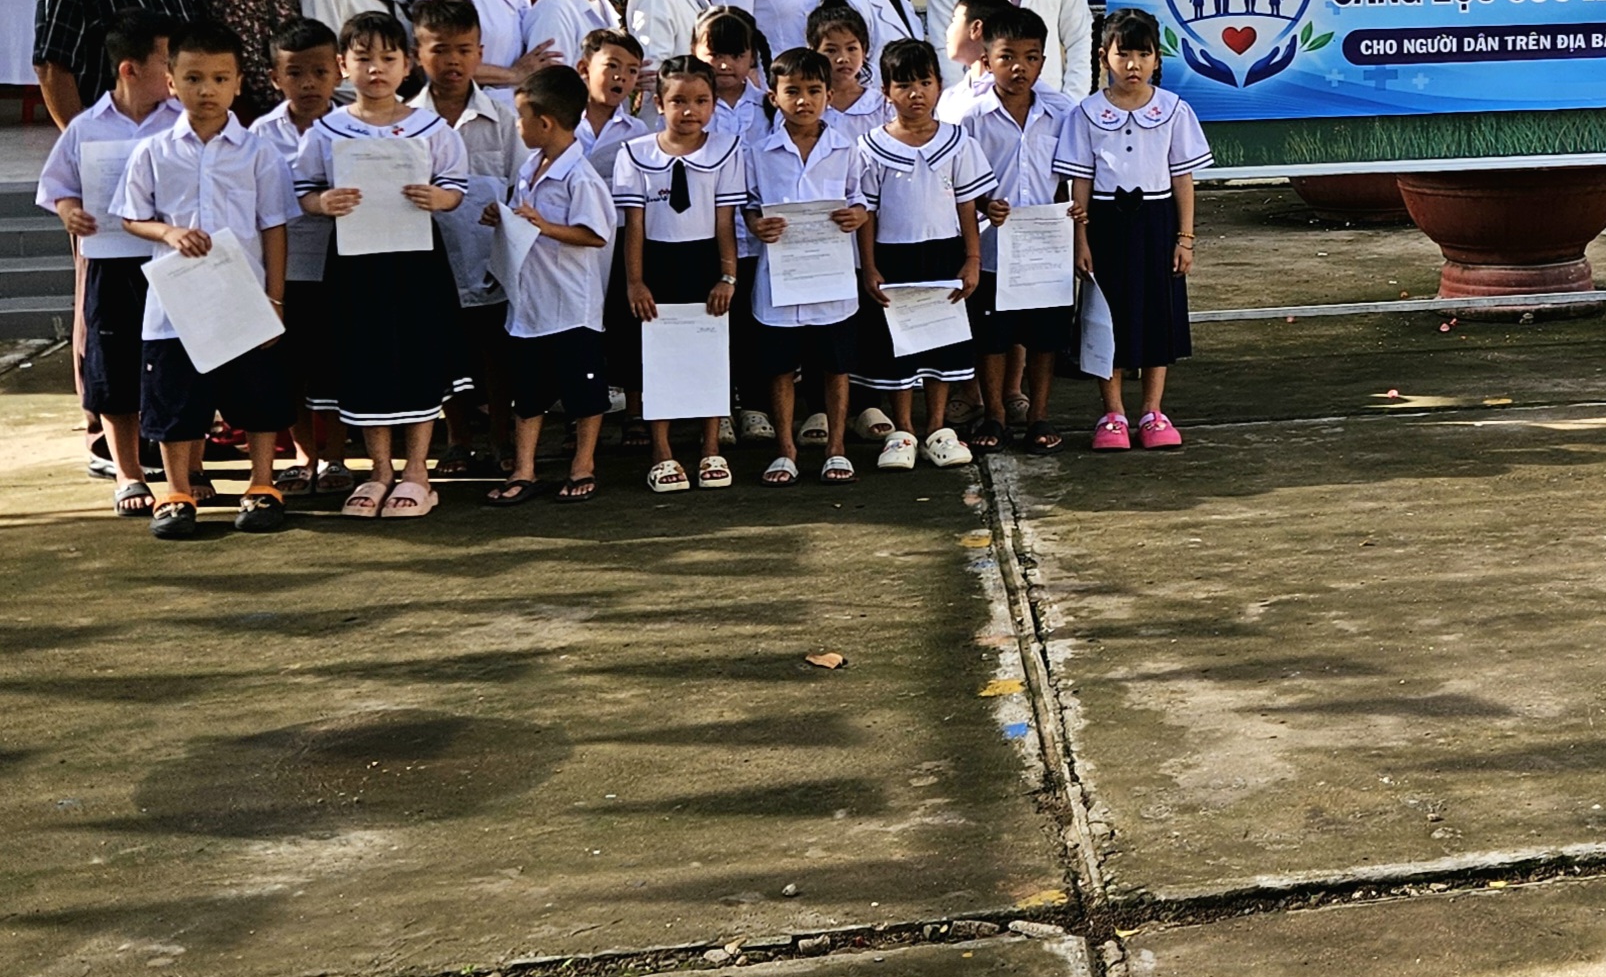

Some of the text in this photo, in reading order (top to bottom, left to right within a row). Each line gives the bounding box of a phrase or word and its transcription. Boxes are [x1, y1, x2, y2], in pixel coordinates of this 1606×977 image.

[1360, 39, 1398, 55] CHO
[1403, 34, 1458, 54] NGƯỜI
[1463, 33, 1499, 52] DÂN
[1504, 32, 1551, 51] TRÊN
[1556, 33, 1586, 53] ĐỊA
